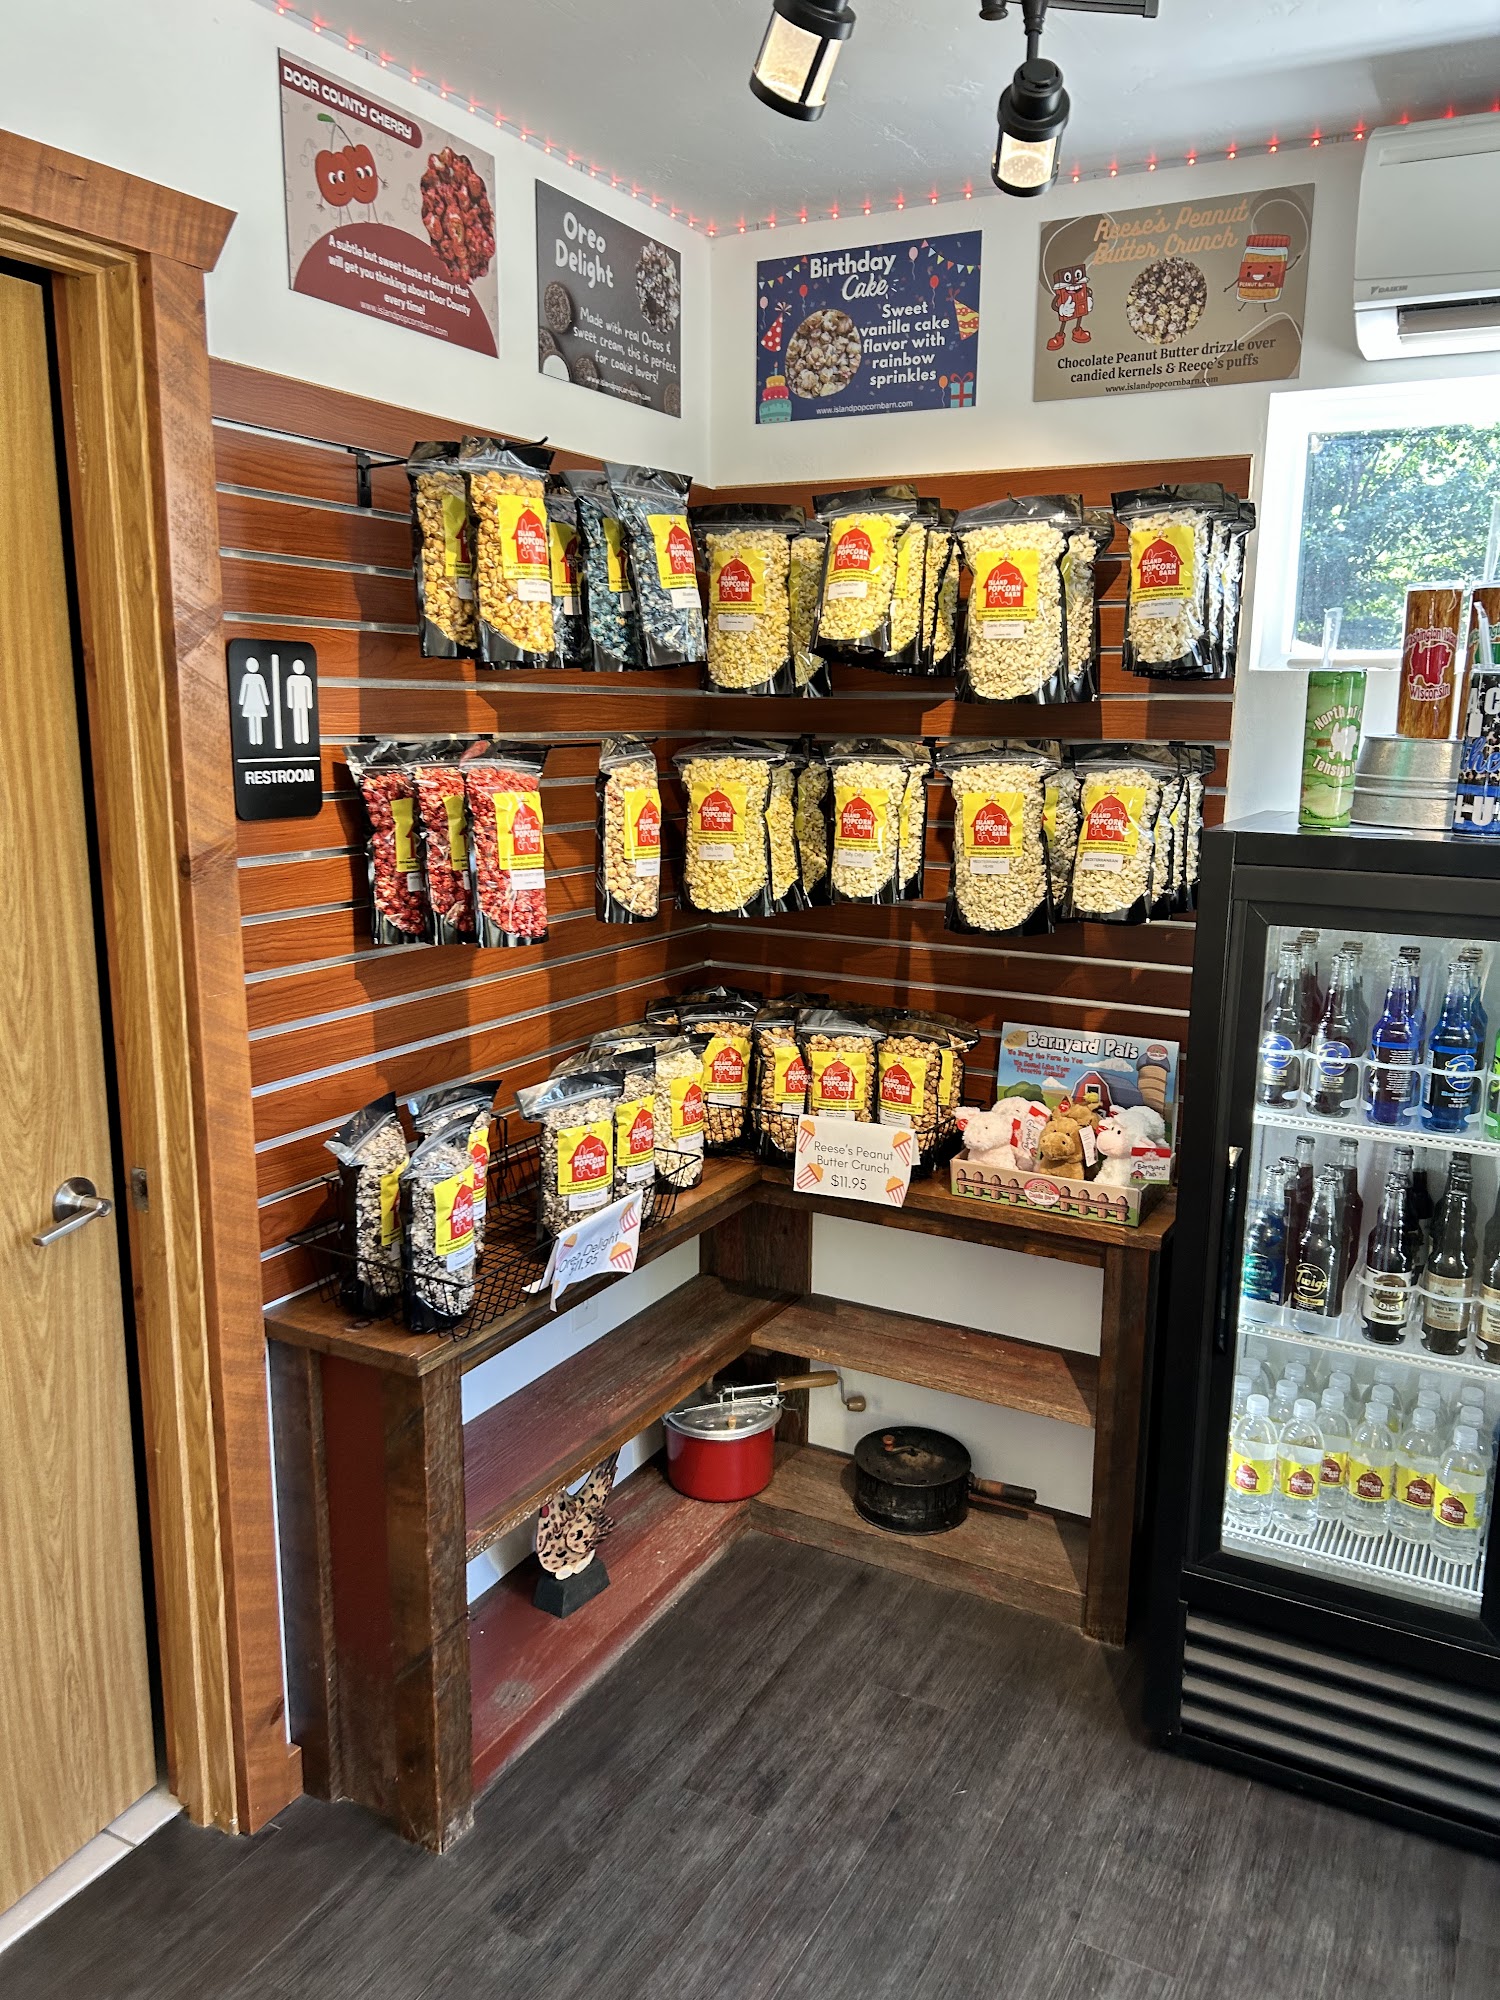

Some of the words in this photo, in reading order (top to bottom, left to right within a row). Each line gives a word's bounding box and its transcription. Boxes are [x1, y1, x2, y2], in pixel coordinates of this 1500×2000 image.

[284, 66, 320, 95] DOOR
[322, 84, 367, 117] COUNTY
[369, 107, 412, 140] CHERRY
[1094, 209, 1171, 241] Reese's
[1175, 199, 1249, 230] Peanut
[564, 211, 606, 254] Oreo
[1094, 239, 1159, 265] Butter
[1164, 226, 1239, 256] Crunch
[328, 234, 336, 247] A
[337, 240, 362, 257] subtle
[363, 247, 378, 263] but
[378, 256, 402, 272] sweet
[402, 264, 422, 280] taste
[423, 272, 431, 283] of
[432, 276, 454, 294] cherry
[455, 284, 469, 298] that
[555, 238, 614, 288] Delight
[810, 251, 896, 279] Birthday
[328, 255, 344, 269] will
[344, 261, 358, 274] get
[360, 266, 374, 278] you
[375, 271, 407, 294] thinking
[408, 283, 428, 300] about
[429, 290, 446, 306] Door
[446, 297, 471, 317] County
[842, 273, 889, 300] Cake
[1378, 285, 1408, 293] DAIKIN
[384, 294, 406, 310] every
[406, 300, 426, 315] time!
[882, 301, 928, 318] Sweet
[581, 307, 603, 328] Made
[605, 321, 622, 335] with
[625, 328, 639, 342] real
[642, 331, 664, 353] Oreos
[860, 319, 910, 337] vanilla
[914, 316, 950, 331] cake
[573, 326, 597, 344] sweet
[600, 336, 625, 356] cream,
[628, 344, 640, 360] this
[643, 352, 649, 363] is
[651, 356, 676, 374] perfect
[863, 337, 908, 354] flavor
[912, 332, 945, 348] with
[1057, 352, 1114, 369] Chocolate
[1116, 350, 1158, 364] Peanut
[1160, 346, 1200, 360] Butter
[1201, 339, 1244, 355] drizzle
[1247, 338, 1277, 350] over
[595, 350, 608, 365] for
[611, 359, 633, 375] cookie
[635, 364, 659, 385] lovers!
[872, 352, 935, 369] rainbow
[1070, 367, 1116, 383] candied
[1118, 362, 1162, 379] kernels
[1165, 362, 1176, 374] &
[1178, 355, 1224, 373] Reece's
[1226, 352, 1259, 370] puffs
[869, 369, 937, 388] sprinkles
[1105, 375, 1218, 393] www.islandpopcornbarn.com
[816, 400, 913, 415] www.islandpopcornbarn.com
[1142, 563, 1176, 572] POPCORN
[1411, 684, 1450, 699] Wisconsin
[1314, 705, 1345, 730] North
[1348, 705, 1358, 718] of
[1313, 755, 1351, 777] Tension
[245, 769, 315, 785] RESTROOM
[1018, 1050, 1033, 1060] Bring
[1027, 1031, 1100, 1055] Barnyard
[1104, 1039, 1139, 1059] Pals
[1016, 1066, 1041, 1075] Favorite
[1044, 1070, 1066, 1078] Animals
[1023, 1061, 1041, 1069] Sound
[884, 1082, 910, 1091] POPCORN
[575, 1153, 594, 1161] ISLAND
[575, 1155, 605, 1167] POPCORN
[815, 1141, 853, 1156] Reese's
[857, 1146, 893, 1161] Peanut
[817, 1154, 848, 1168] Butter
[852, 1160, 890, 1174] Crunch
[1137, 1163, 1166, 1171] Barnyard
[831, 1174, 867, 1190] $11.95
[559, 1252, 581, 1273] Oreo
[583, 1231, 619, 1257] Delight
[569, 1252, 599, 1276] $11.95
[1379, 1302, 1400, 1311] Diet
